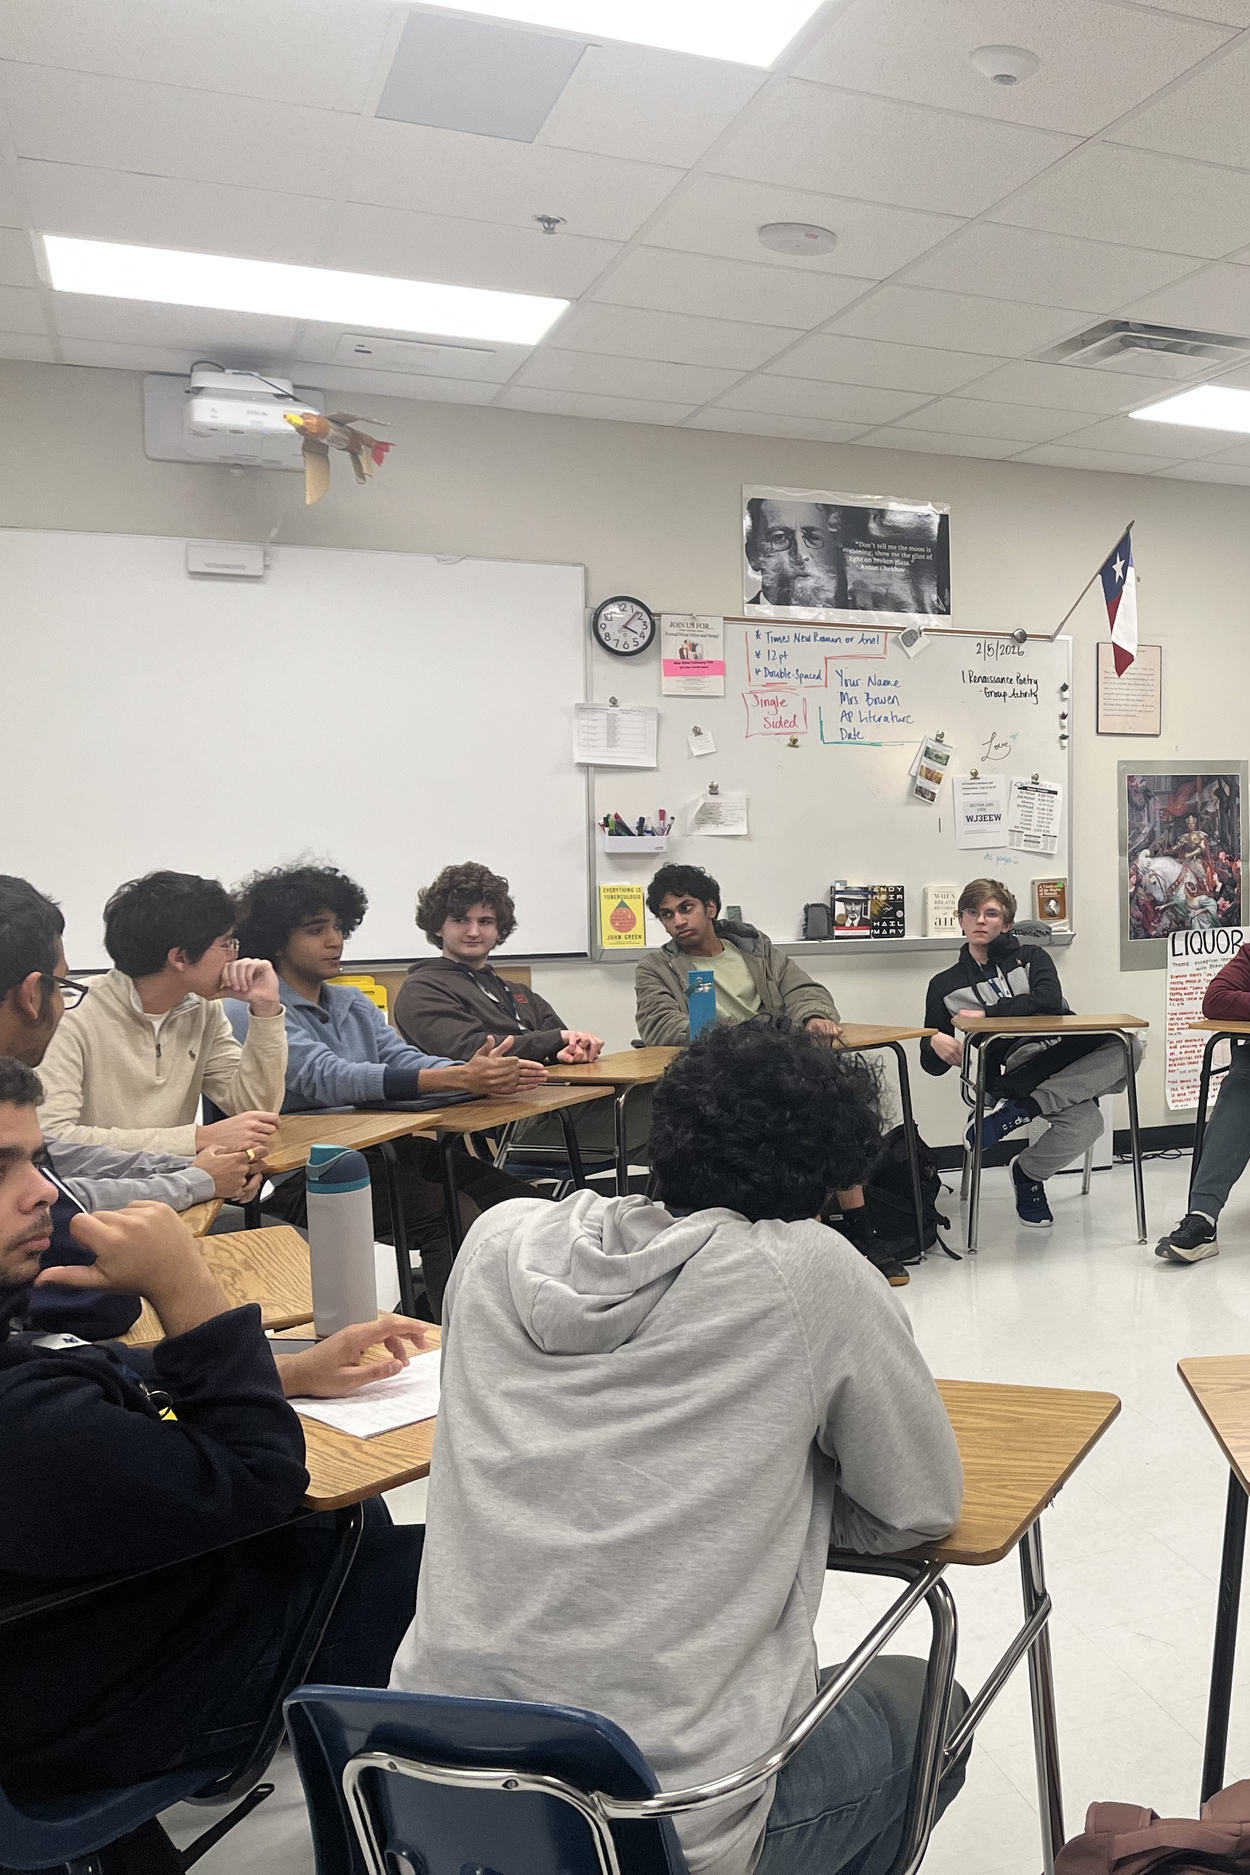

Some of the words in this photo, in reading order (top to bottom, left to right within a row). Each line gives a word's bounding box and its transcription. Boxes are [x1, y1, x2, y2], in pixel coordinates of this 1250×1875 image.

[618, 603, 627, 612] 12
[600, 623, 606, 632] 9
[642, 621, 648, 629] 3
[605, 633, 611, 641] 8
[639, 631, 646, 640] 4
[765, 632, 790, 643] Times
[794, 632, 810, 642] New
[814, 632, 842, 643] Roman
[613, 639, 619, 648] 7
[623, 641, 629, 649] 6
[633, 638, 639, 647] 5
[976, 639, 1024, 661] 2/5/2026
[836, 669, 861, 687] Your
[868, 675, 901, 688] Name
[968, 670, 1014, 684] Renaissance
[1016, 672, 1038, 691] Poetry
[865, 692, 900, 706] Bowen
[752, 695, 788, 715] Single
[764, 714, 799, 729] Sided
[840, 710, 853, 723] AP
[859, 710, 914, 724] Literature
[840, 727, 864, 740] Date
[981, 732, 1011, 761] Love
[966, 814, 1002, 822] WJ3EEW
[934, 917, 956, 926] air
[1171, 929, 1245, 957] LIQUOR
